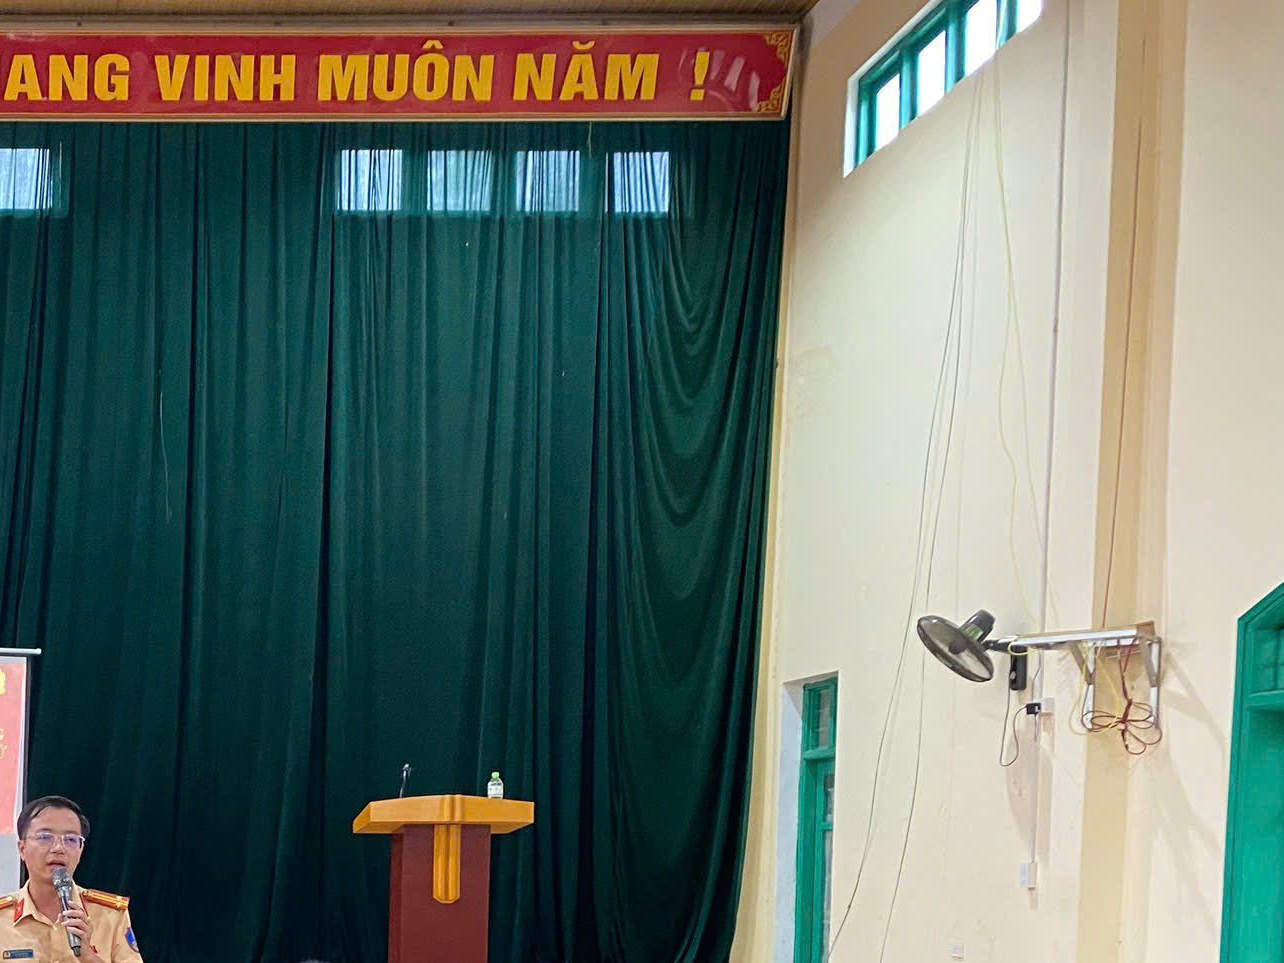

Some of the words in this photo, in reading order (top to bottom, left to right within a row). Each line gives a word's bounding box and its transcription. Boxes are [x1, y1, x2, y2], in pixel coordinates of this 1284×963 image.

[154, 55, 296, 102] VINH
[317, 39, 496, 102] MUÔN
[513, 41, 659, 101] NĂM
[690, 51, 709, 101] !
